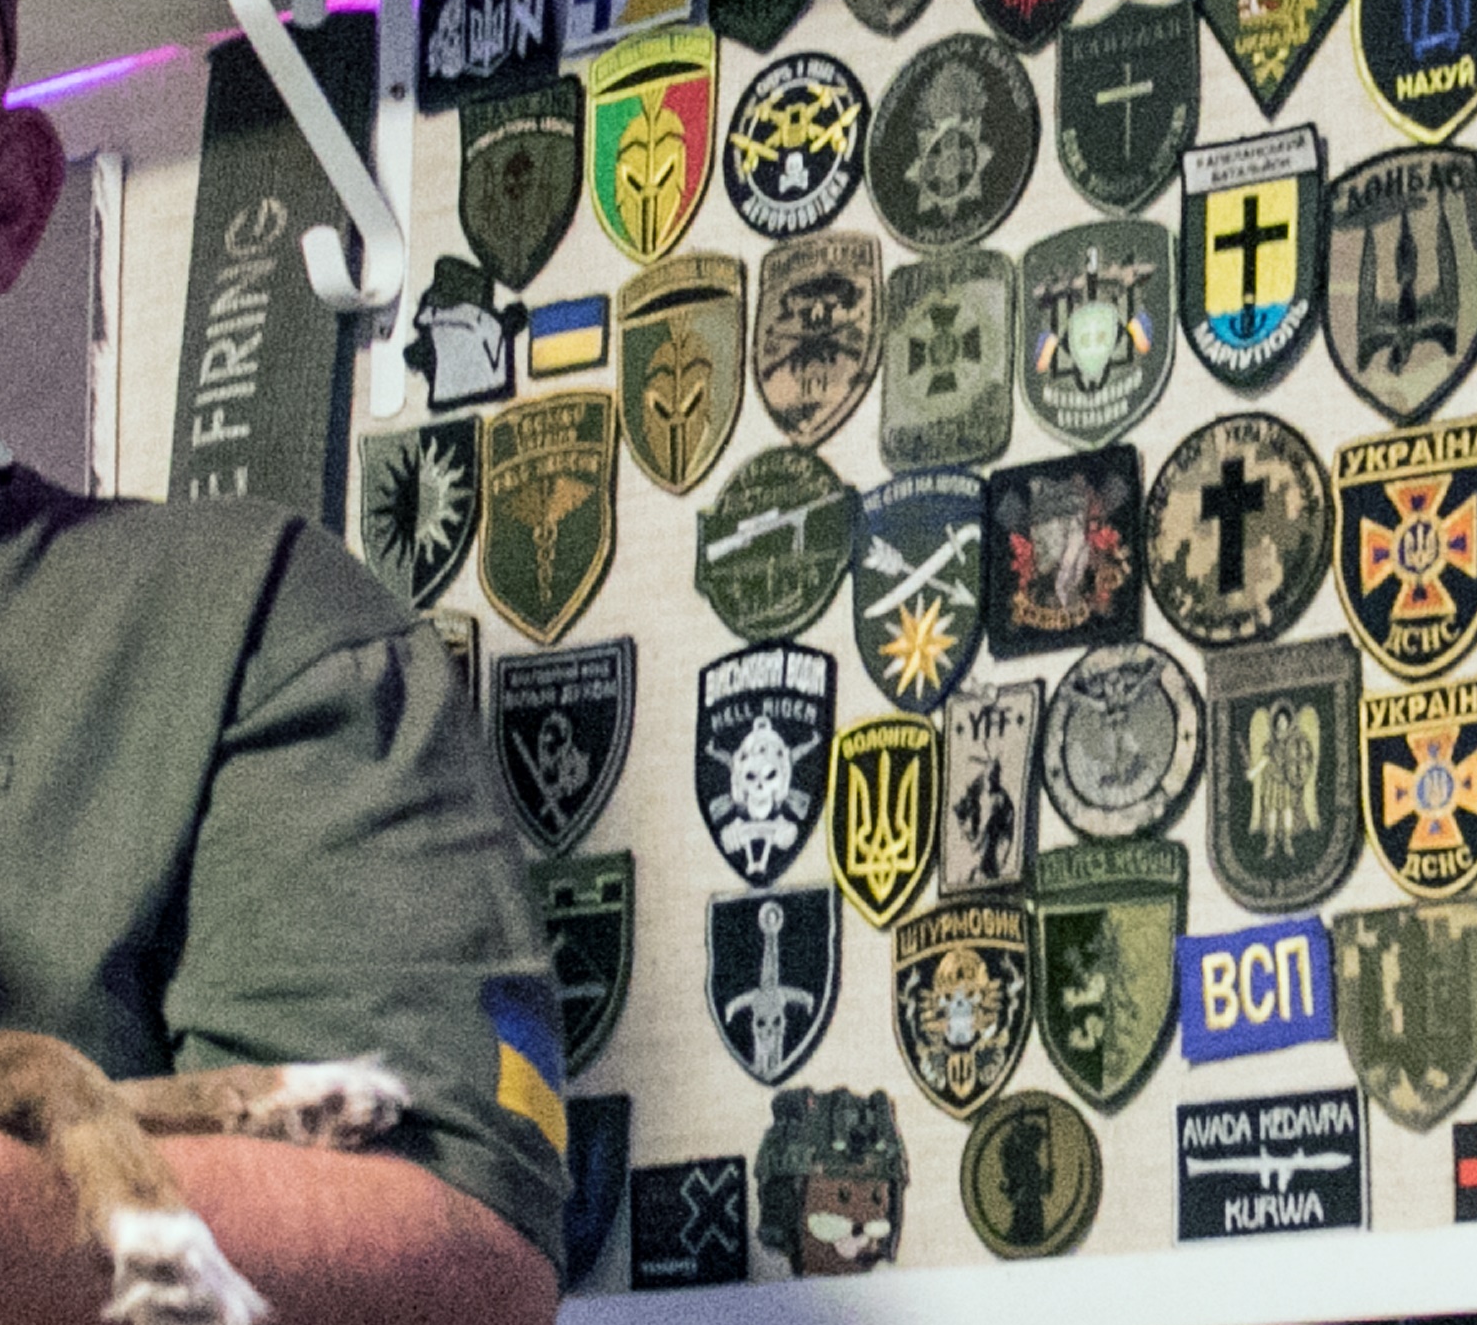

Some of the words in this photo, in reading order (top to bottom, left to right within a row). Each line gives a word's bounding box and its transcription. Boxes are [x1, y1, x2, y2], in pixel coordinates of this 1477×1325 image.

[1396, 53, 1477, 103] НАХУЙ
[192, 195, 289, 450] FIRING
[1193, 297, 1311, 372] МАРІУПОЛЬ
[1383, 618, 1462, 655] ДСНС
[840, 725, 932, 762] ВОЛОНТЕР
[968, 702, 1015, 743] YFF
[1401, 845, 1474, 881] ДСНС
[897, 905, 1024, 967] ШТУРМОВИК
[1201, 933, 1316, 1032] ВСП
[1181, 1109, 1253, 1151] AVADA
[1223, 1191, 1326, 1233] KURWA
